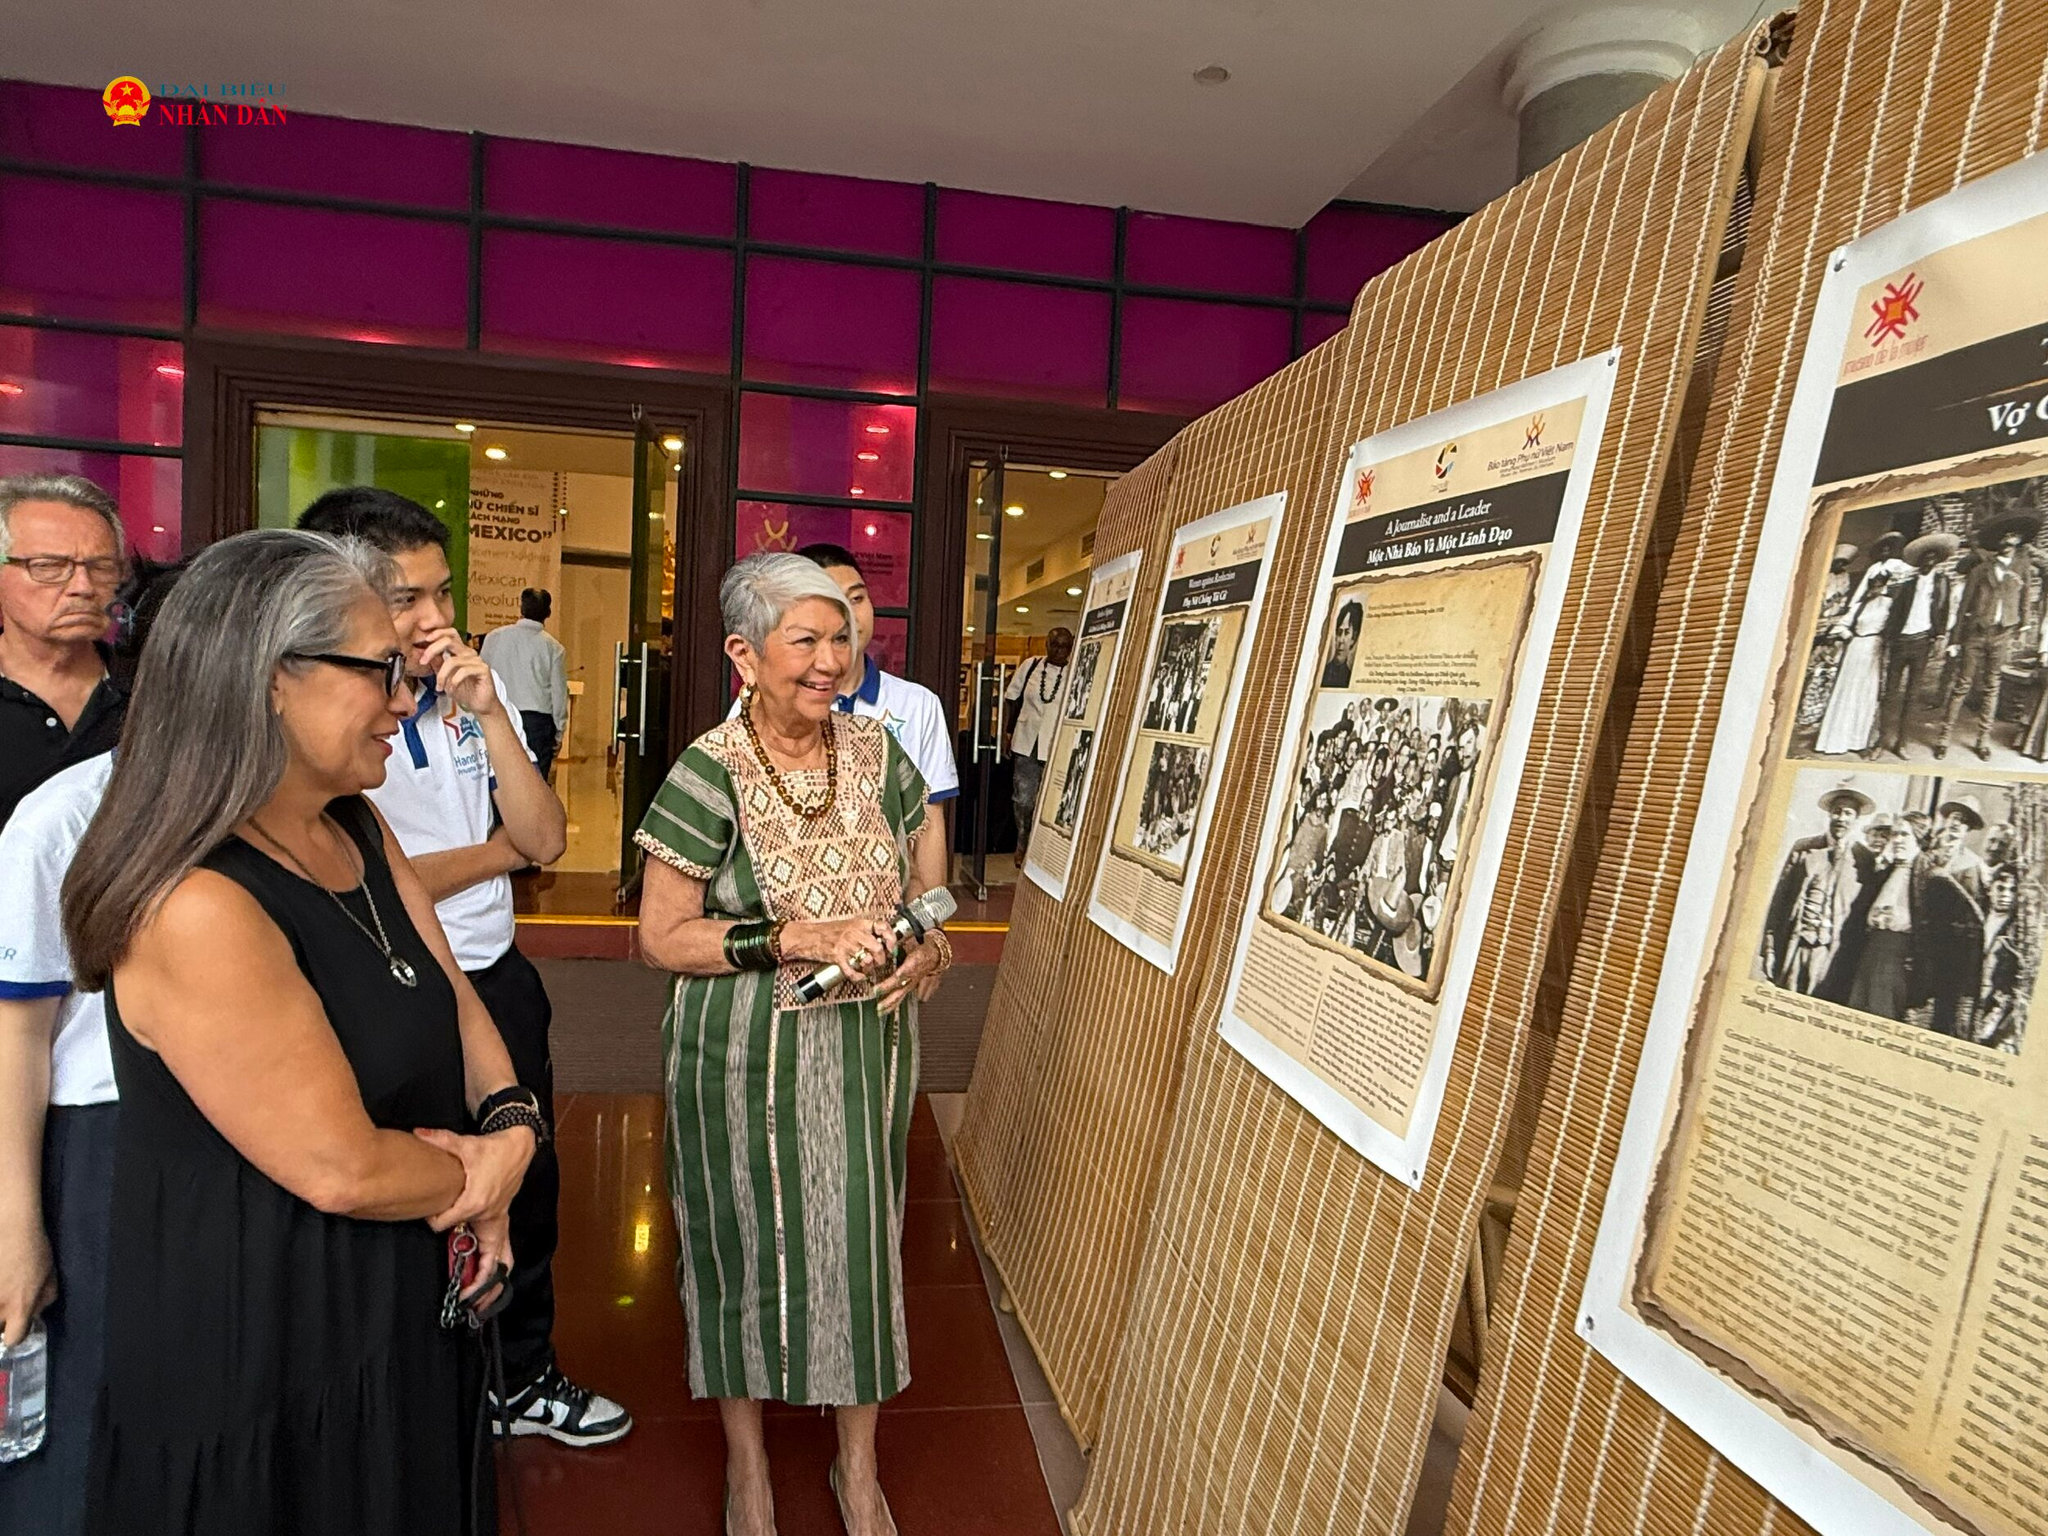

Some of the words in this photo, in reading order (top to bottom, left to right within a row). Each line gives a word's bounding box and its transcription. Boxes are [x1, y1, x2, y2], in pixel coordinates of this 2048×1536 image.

[1987, 401, 2031, 435] Vợ
[1432, 506, 1450, 525] and
[1450, 511, 1457, 522] a
[1458, 499, 1492, 519] Leader
[1488, 526, 1513, 545] Đạo
